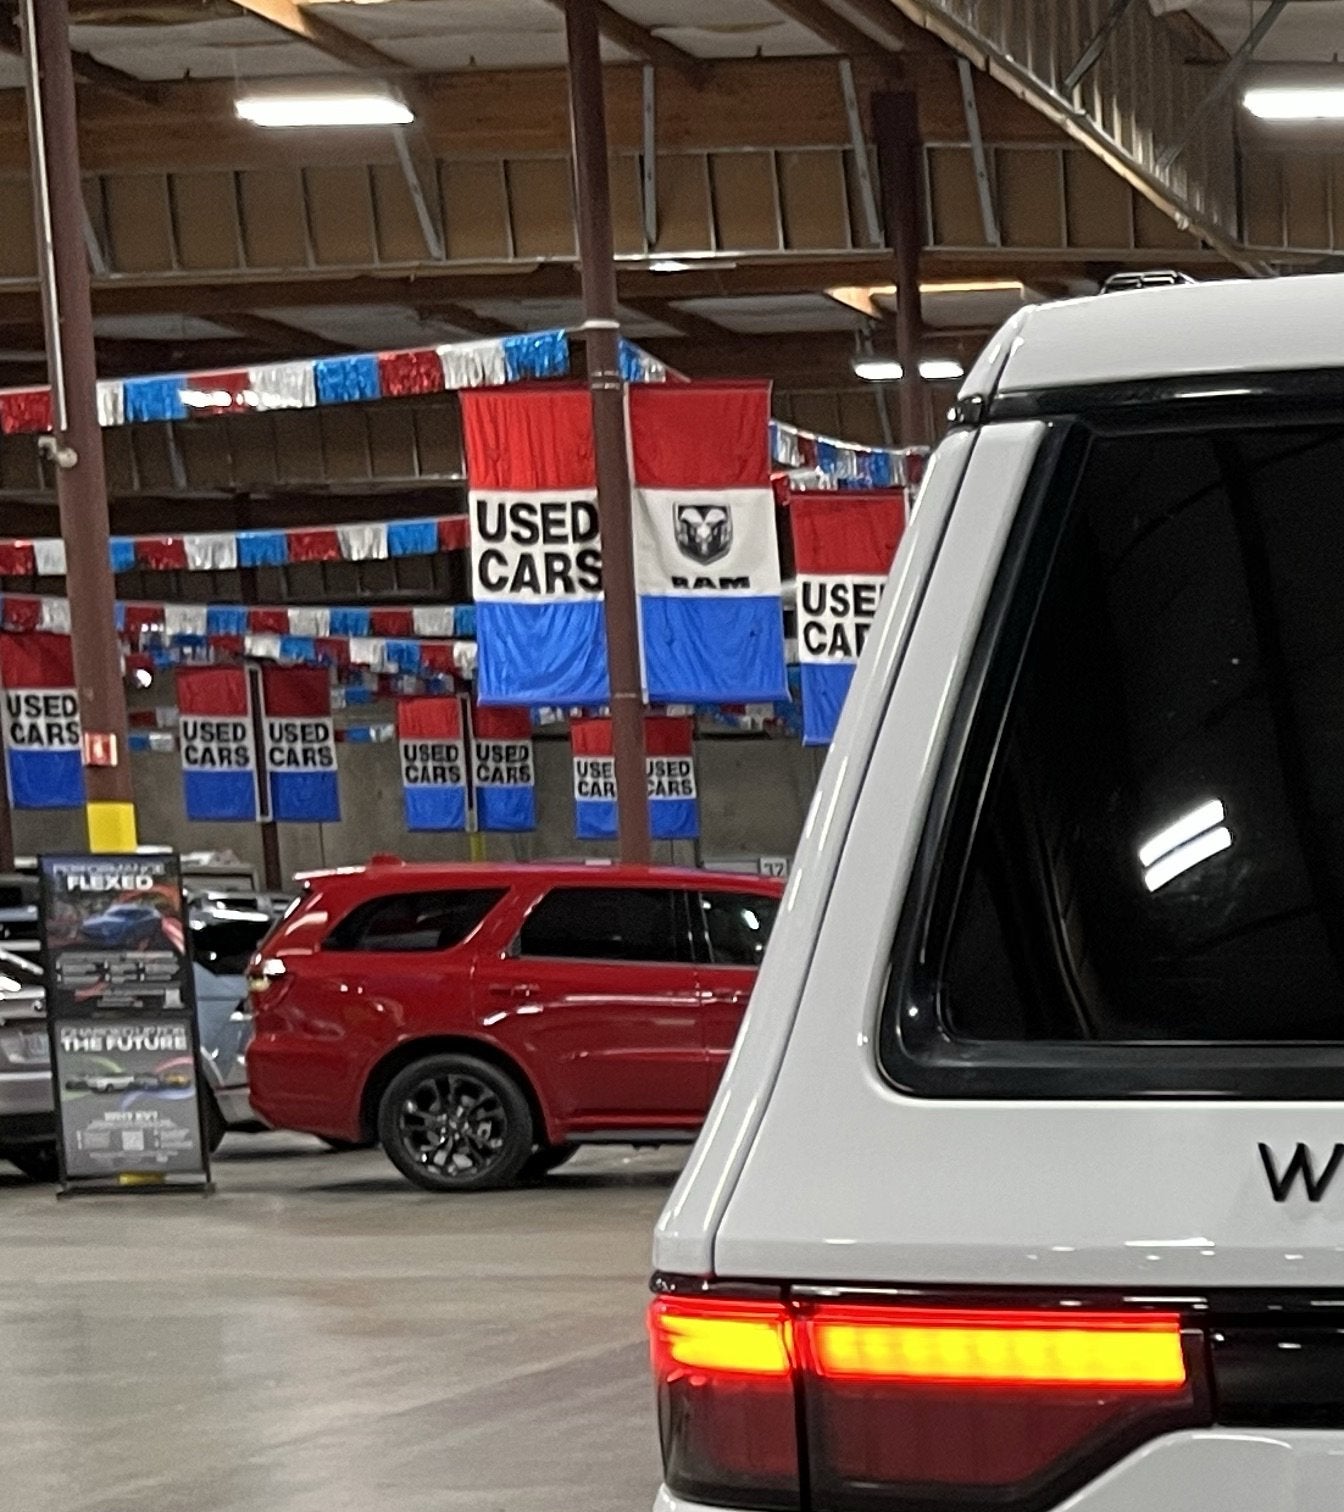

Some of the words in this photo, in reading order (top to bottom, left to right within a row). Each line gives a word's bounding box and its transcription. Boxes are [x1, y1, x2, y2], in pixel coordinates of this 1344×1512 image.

[476, 500, 600, 545] USED
[478, 549, 602, 594] CARS
[671, 576, 751, 589] RAM
[802, 581, 886, 617] USE
[7, 694, 78, 717] USED
[10, 721, 80, 745] CARS
[183, 721, 247, 743] USED
[269, 723, 329, 743] USED
[184, 745, 250, 766] CARS
[269, 747, 333, 766] CARS
[404, 744, 459, 761] USED
[476, 744, 529, 762] USED
[405, 764, 461, 783] CARS
[476, 764, 531, 783] CARS
[577, 761, 612, 778] USE
[578, 780, 616, 798] CAR
[66, 875, 154, 892] FLEXED
[61, 1037, 103, 1052] THE
[106, 1036, 188, 1051] FUTURE
